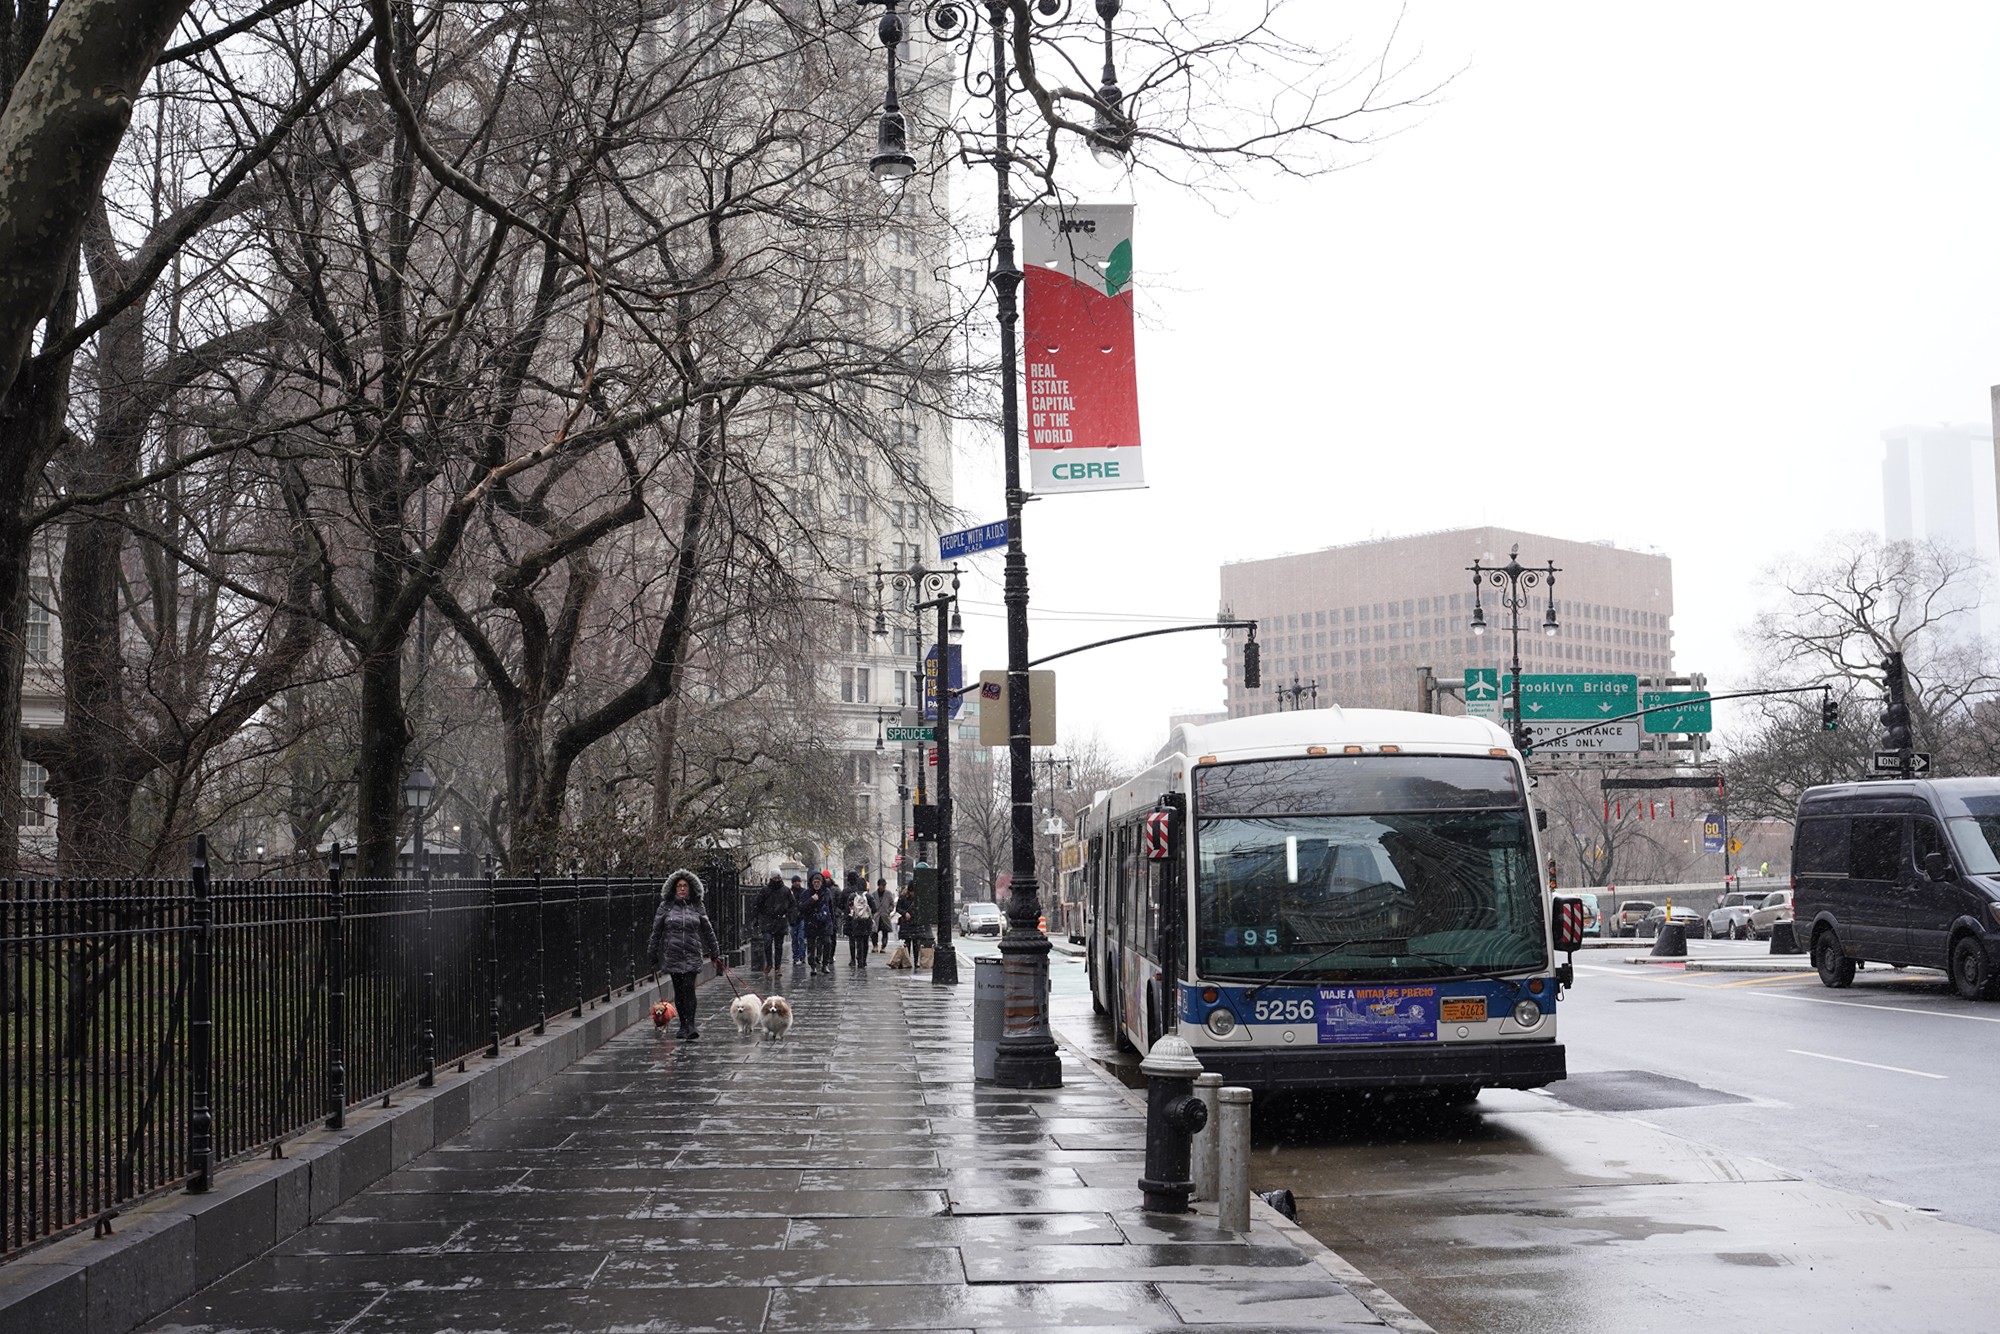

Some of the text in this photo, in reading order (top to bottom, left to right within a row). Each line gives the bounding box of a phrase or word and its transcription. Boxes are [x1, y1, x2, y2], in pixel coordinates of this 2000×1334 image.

[1060, 220, 1096, 233] NYC
[1030, 363, 1057, 378] REAL
[1031, 380, 1069, 395] ESTATE
[1032, 396, 1075, 411] CAPITAL
[1033, 413, 1070, 427] OF THE
[1034, 429, 1073, 444] WORLD
[1052, 461, 1120, 480] CBRE
[942, 532, 965, 551] PEOPLE
[967, 528, 984, 545] WITH
[964, 543, 983, 553] PLAZA
[1511, 681, 1629, 696] rooklyn Bridge
[1676, 703, 1705, 713] Drive
[888, 728, 926, 740] SPRUCE
[1575, 739, 1604, 747] ONLY
[1882, 757, 1898, 767] ONE
[1705, 822, 1719, 834] GO
[1320, 990, 1346, 999] VIAJE
[1347, 990, 1355, 999] A
[1356, 988, 1385, 999] MITAD
[1401, 987, 1434, 998] PRECIO
[1255, 999, 1315, 1021] 5256
